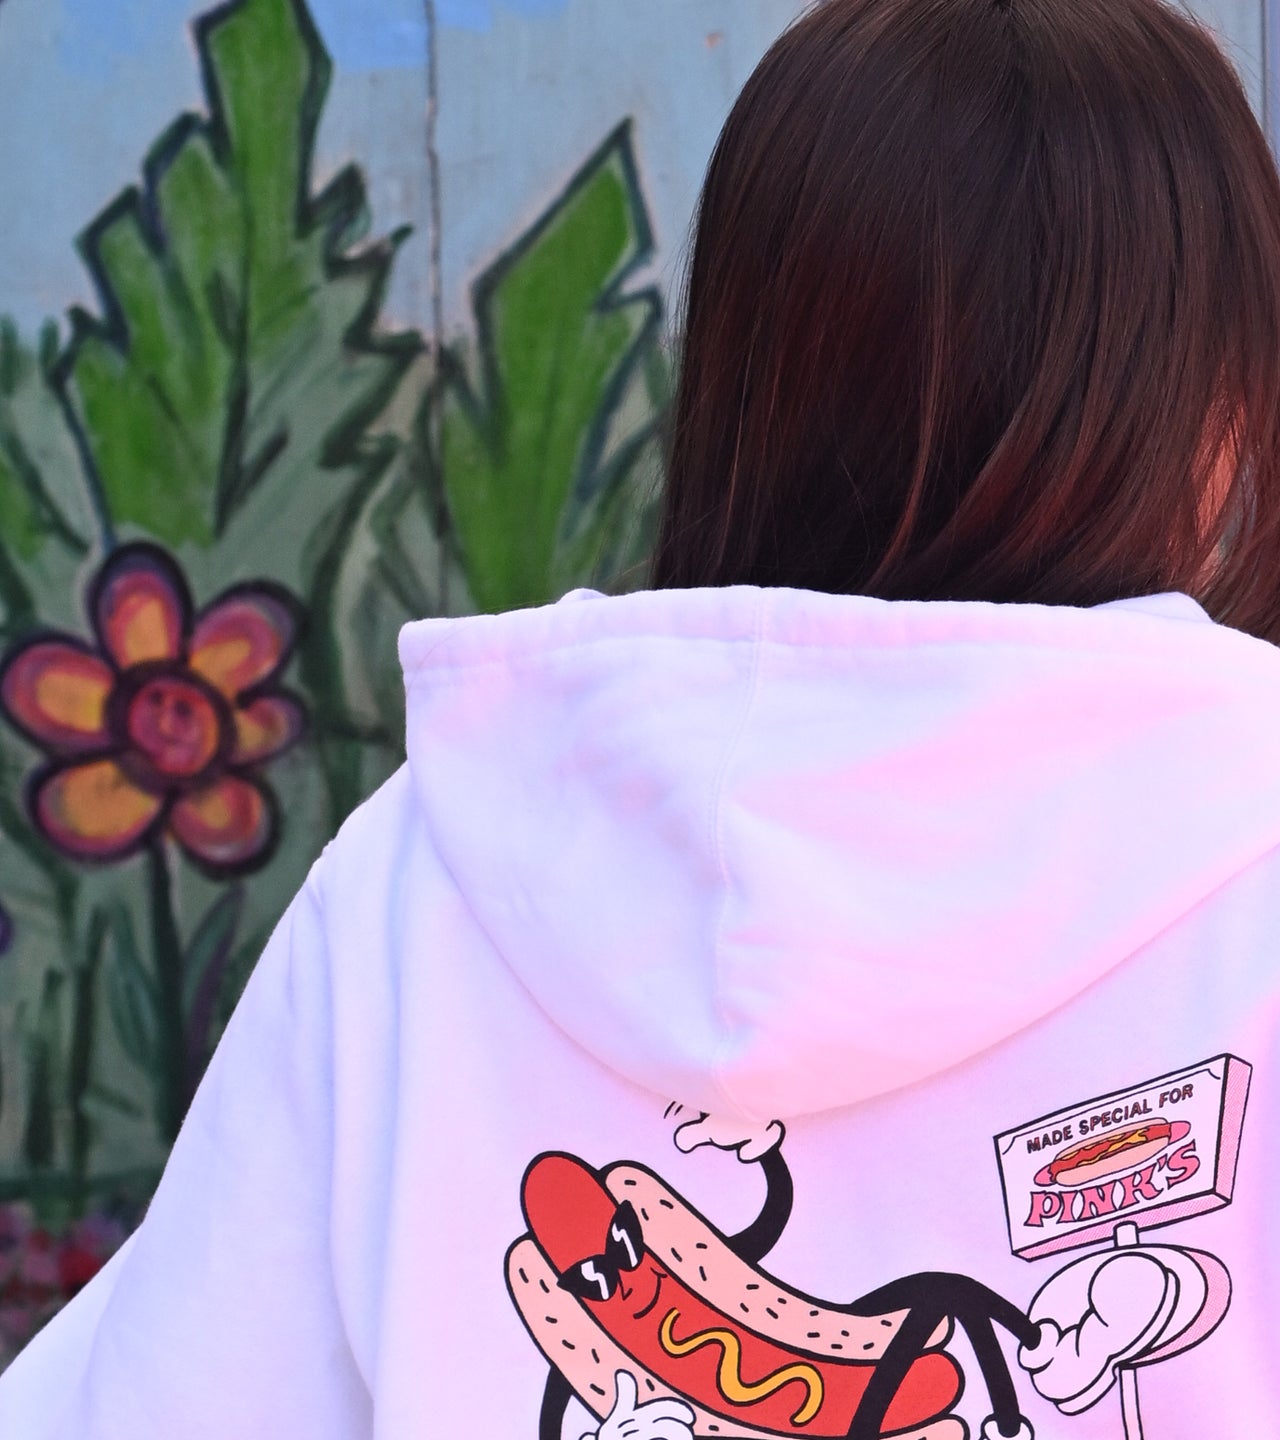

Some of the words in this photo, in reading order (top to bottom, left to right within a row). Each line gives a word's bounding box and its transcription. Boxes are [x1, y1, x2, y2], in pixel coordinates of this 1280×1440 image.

[1027, 1124, 1074, 1154] MADE
[1079, 1099, 1152, 1136] SPECIAL
[1159, 1083, 1194, 1108] FOR
[1023, 1139, 1200, 1227] PINK'S
